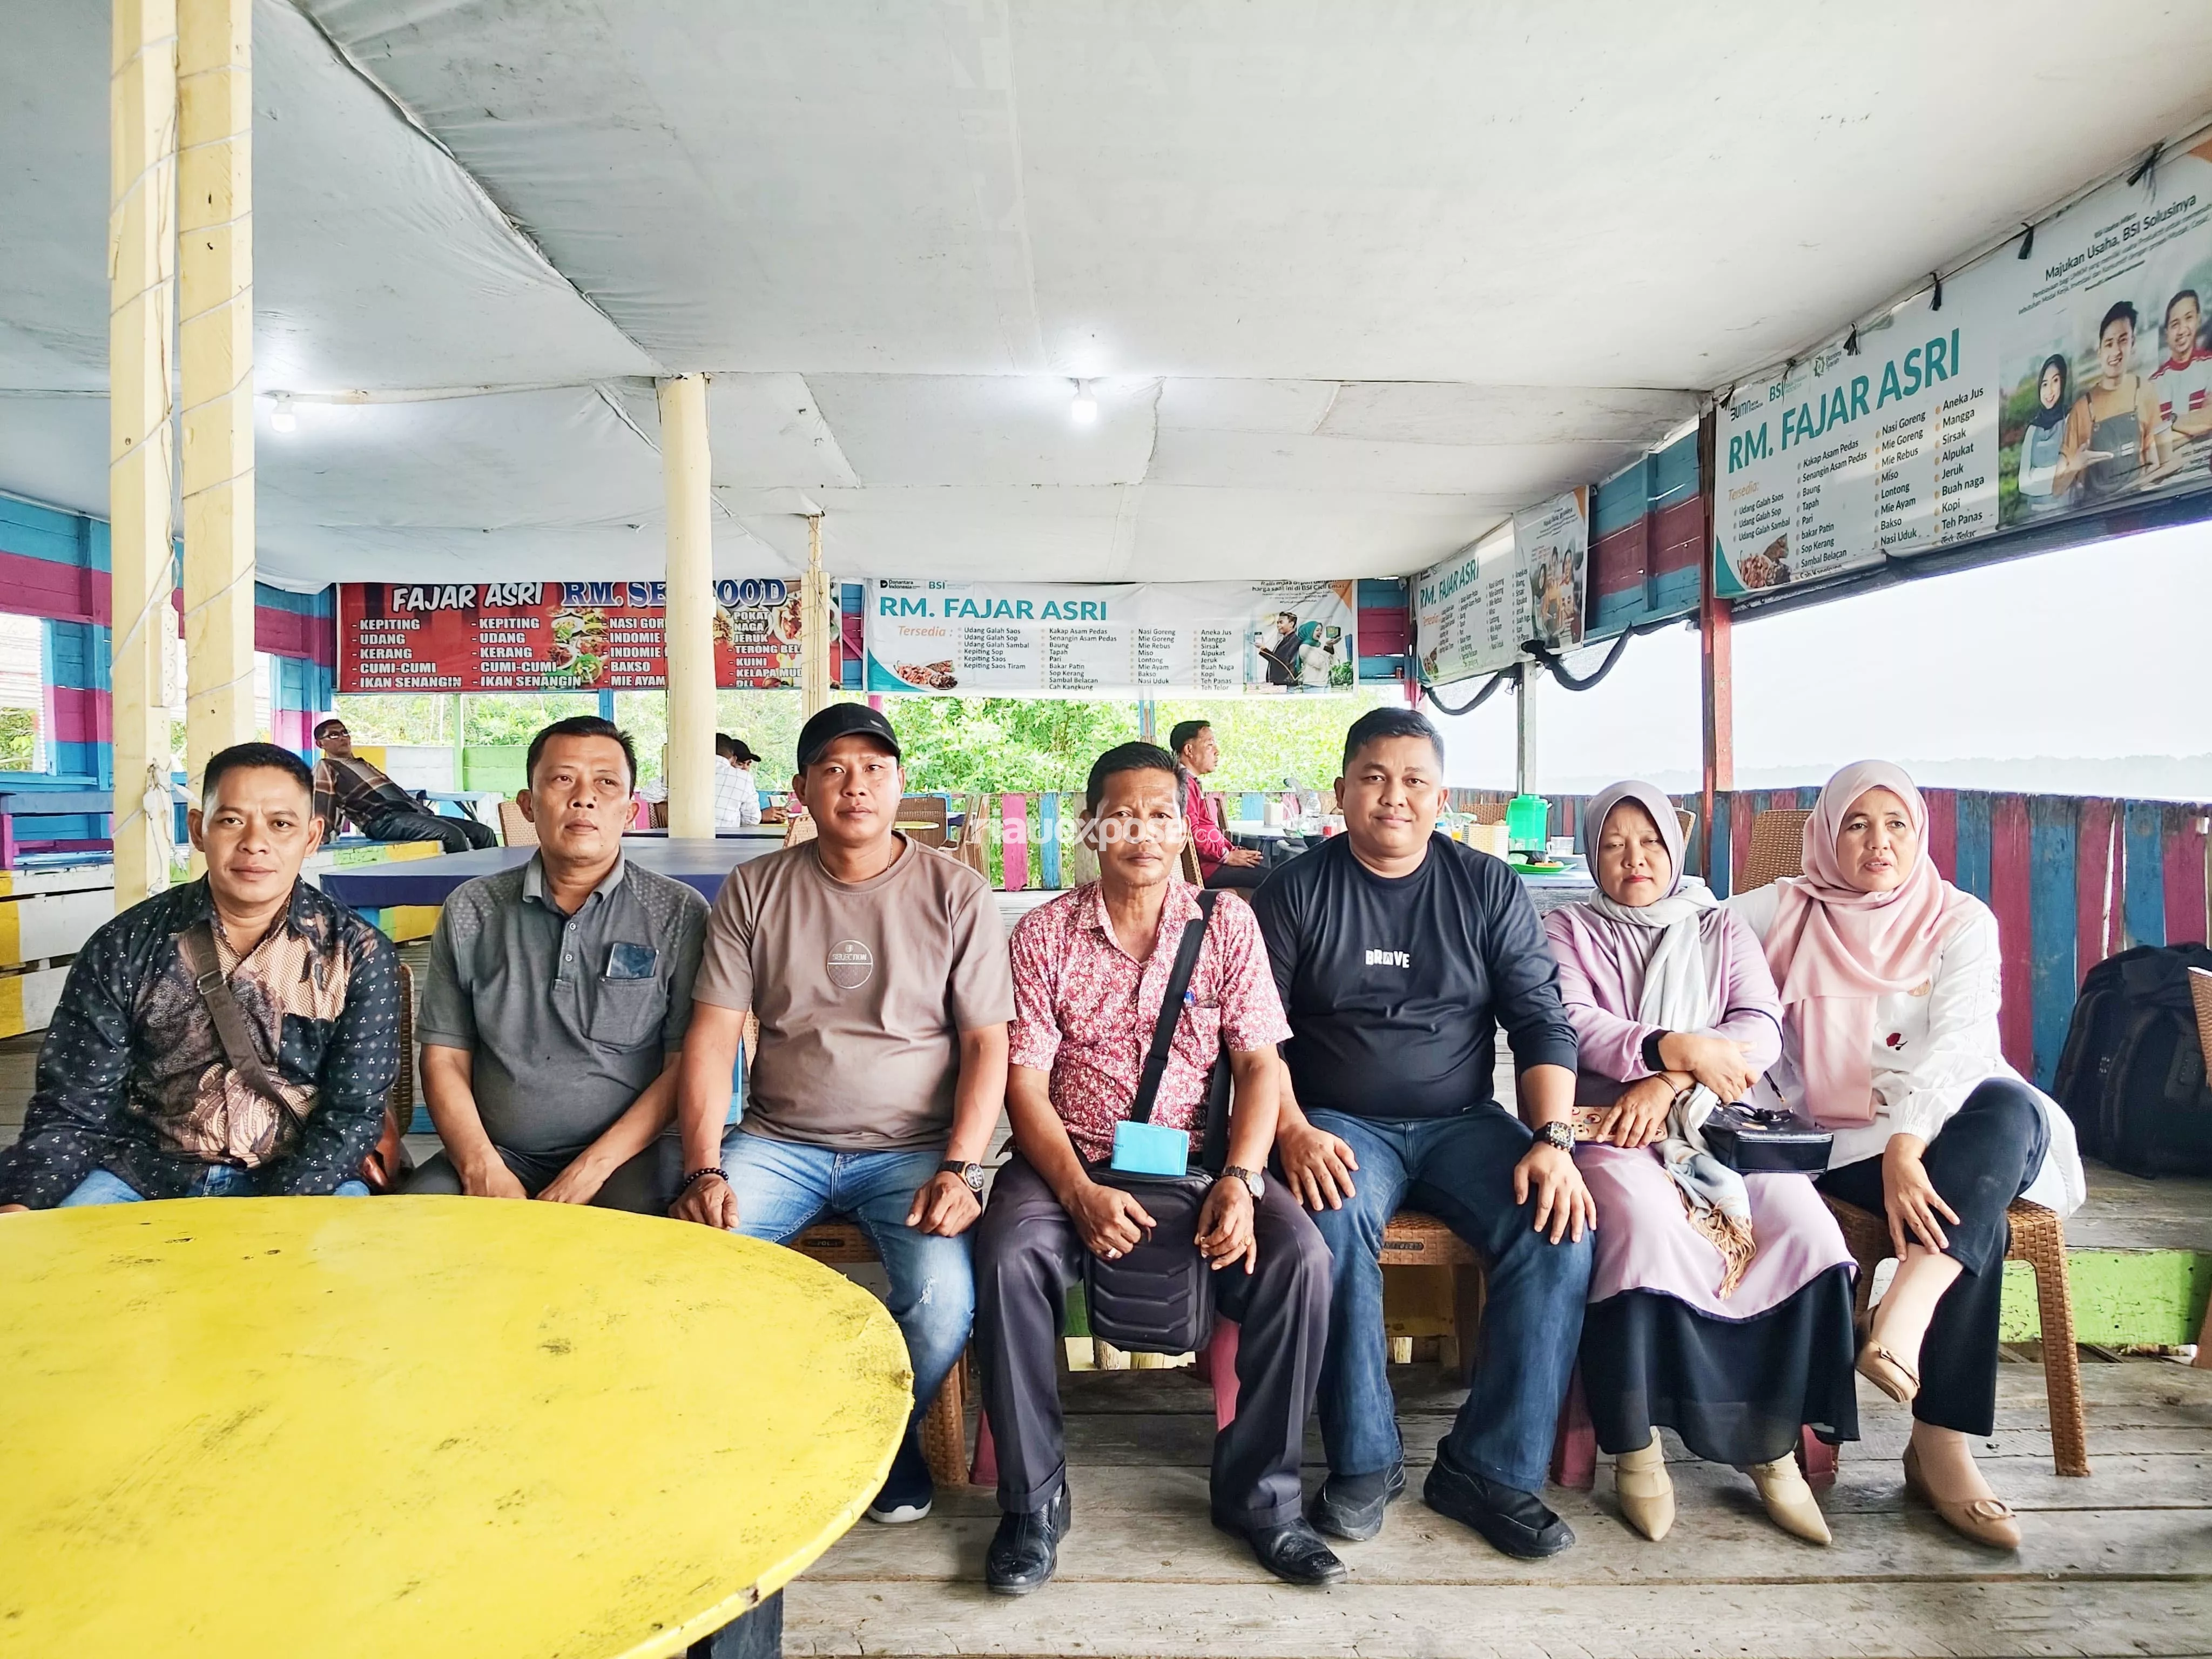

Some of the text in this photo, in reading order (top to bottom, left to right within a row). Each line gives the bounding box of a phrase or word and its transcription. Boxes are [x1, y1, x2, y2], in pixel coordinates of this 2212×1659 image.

[2046, 253, 2085, 281] Majukan
[2123, 221, 2140, 241] BSI
[2143, 195, 2196, 231] Solusinya
[1729, 327, 1959, 474] RM. FAJAR ASRI
[1943, 387, 1984, 412] Aneka Jus
[1882, 412, 1926, 436] Nasi Goreng
[1943, 408, 1975, 428] Mangga
[1882, 429, 1924, 451] Mie Goreng
[1942, 427, 1966, 445] Sirsak
[1803, 440, 1859, 468] Kakap Asam Pedas
[1881, 448, 1918, 467] Mie Rebus
[1941, 442, 1974, 463] Alpukat
[1803, 451, 1867, 482] Senangin Asam Pedas
[1941, 463, 1964, 480] Jeruk
[1881, 468, 1899, 483] Miso
[1803, 484, 1821, 497] Baung
[1881, 483, 1910, 499] Lontong
[1942, 476, 1985, 496] Buah naga
[1802, 497, 1819, 511] Tapah
[1881, 497, 1916, 515] Mie Ayam
[1942, 498, 1960, 513] Kopi
[1802, 512, 1813, 525] Pari
[1880, 518, 1902, 530] Bakso
[1941, 512, 1982, 530] Teh Panas
[1739, 517, 1790, 541] Udang Galah Sambal
[1802, 522, 1835, 539] bakar Patin
[1880, 527, 1917, 546] Nasi Uduk
[1801, 538, 1835, 554] Sop Kerang
[1801, 554, 1822, 568] Sambal
[929, 581, 946, 590] BSI
[1420, 556, 1479, 610] RM. FAJAR ASRI
[393, 582, 543, 612] FAJAR ASRI
[561, 579, 787, 608] RM. SEOOD
[880, 596, 1107, 621] RM. FAJAR ASRI
[733, 611, 770, 621] POKAT
[360, 619, 421, 630] KEPITING
[479, 618, 540, 629] KEPITING
[610, 618, 666, 629] NASI GOR
[734, 623, 765, 631] NAGA
[480, 633, 525, 643] UDANG
[610, 632, 660, 643] INDOMIE
[898, 625, 946, 637] Tersedia
[360, 634, 406, 645] UDANG
[734, 634, 768, 643] JERUK
[360, 648, 413, 659] KERANG
[480, 647, 533, 658] KERANG
[610, 647, 661, 658] INDOMIE
[734, 645, 778, 654] TERONG
[360, 663, 436, 674] CUMI-CUMI
[481, 661, 557, 672] CUMI-CUMI
[610, 661, 651, 672] BAKSO
[736, 657, 767, 666] KUINI
[736, 668, 802, 678] KELAPA MUD
[360, 676, 462, 688] IKAN SENANGIN
[481, 676, 582, 686] IKAN SENANGIN
[611, 676, 665, 686] MIE AYAM
[736, 679, 754, 687] DLL
[1366, 949, 1410, 968] BRAVE
